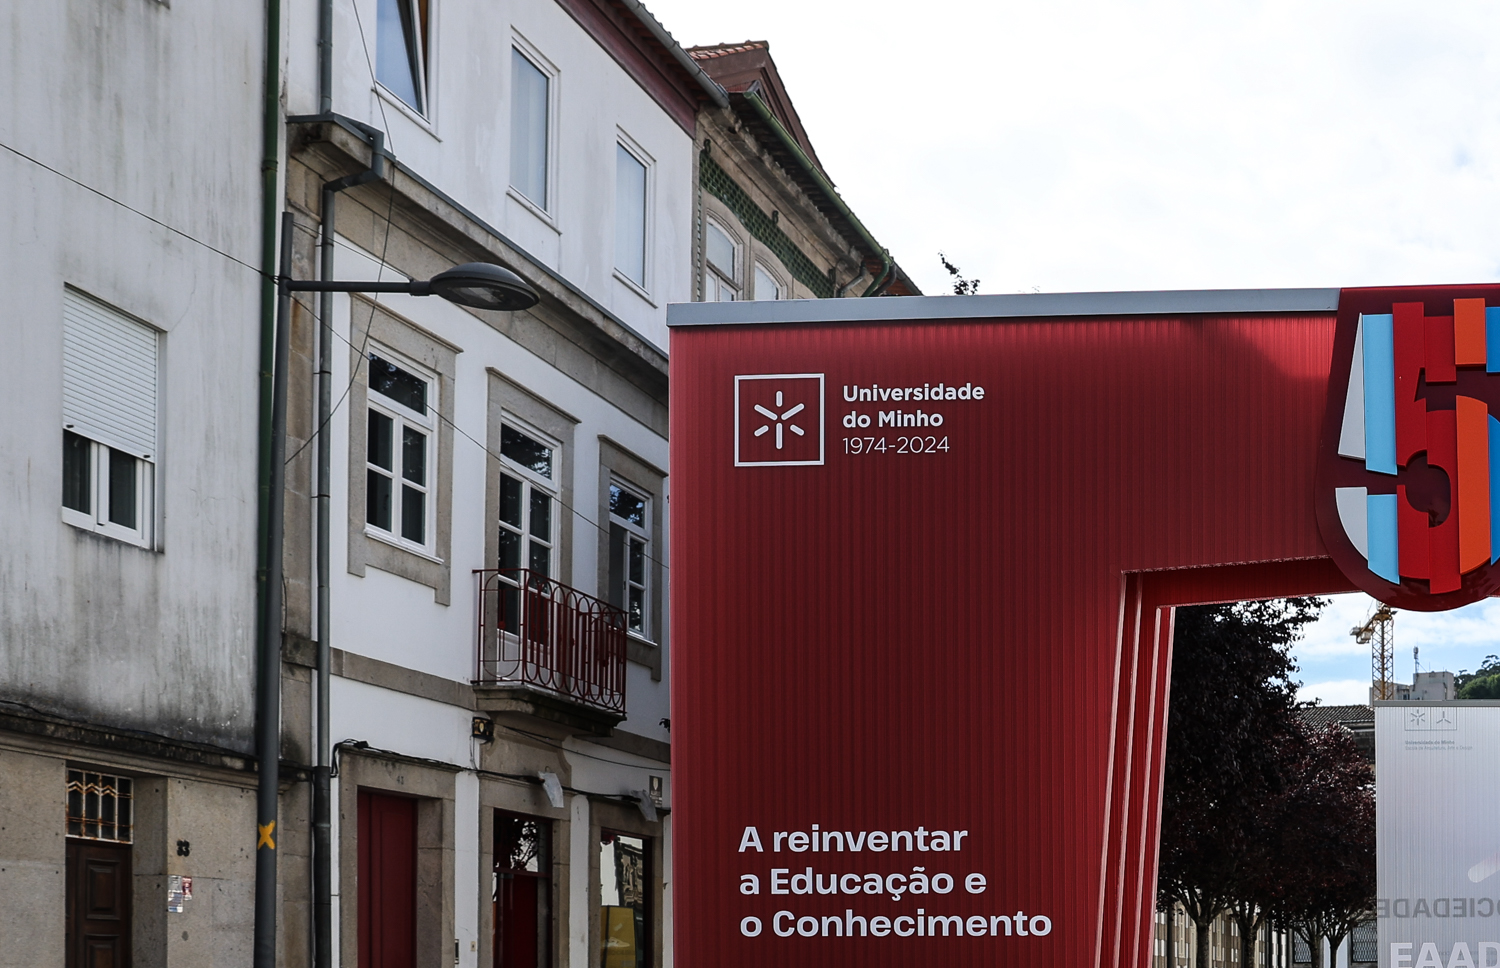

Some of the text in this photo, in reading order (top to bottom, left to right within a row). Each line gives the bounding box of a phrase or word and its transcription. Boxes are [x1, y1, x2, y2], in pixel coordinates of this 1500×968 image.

[843, 382, 984, 402] Universidade
[842, 409, 943, 428] do Minho
[842, 436, 950, 454] 1974-2024
[738, 823, 968, 852] A reinventar
[739, 866, 986, 901] a Educação e
[740, 908, 1051, 937] o Conhecimento
